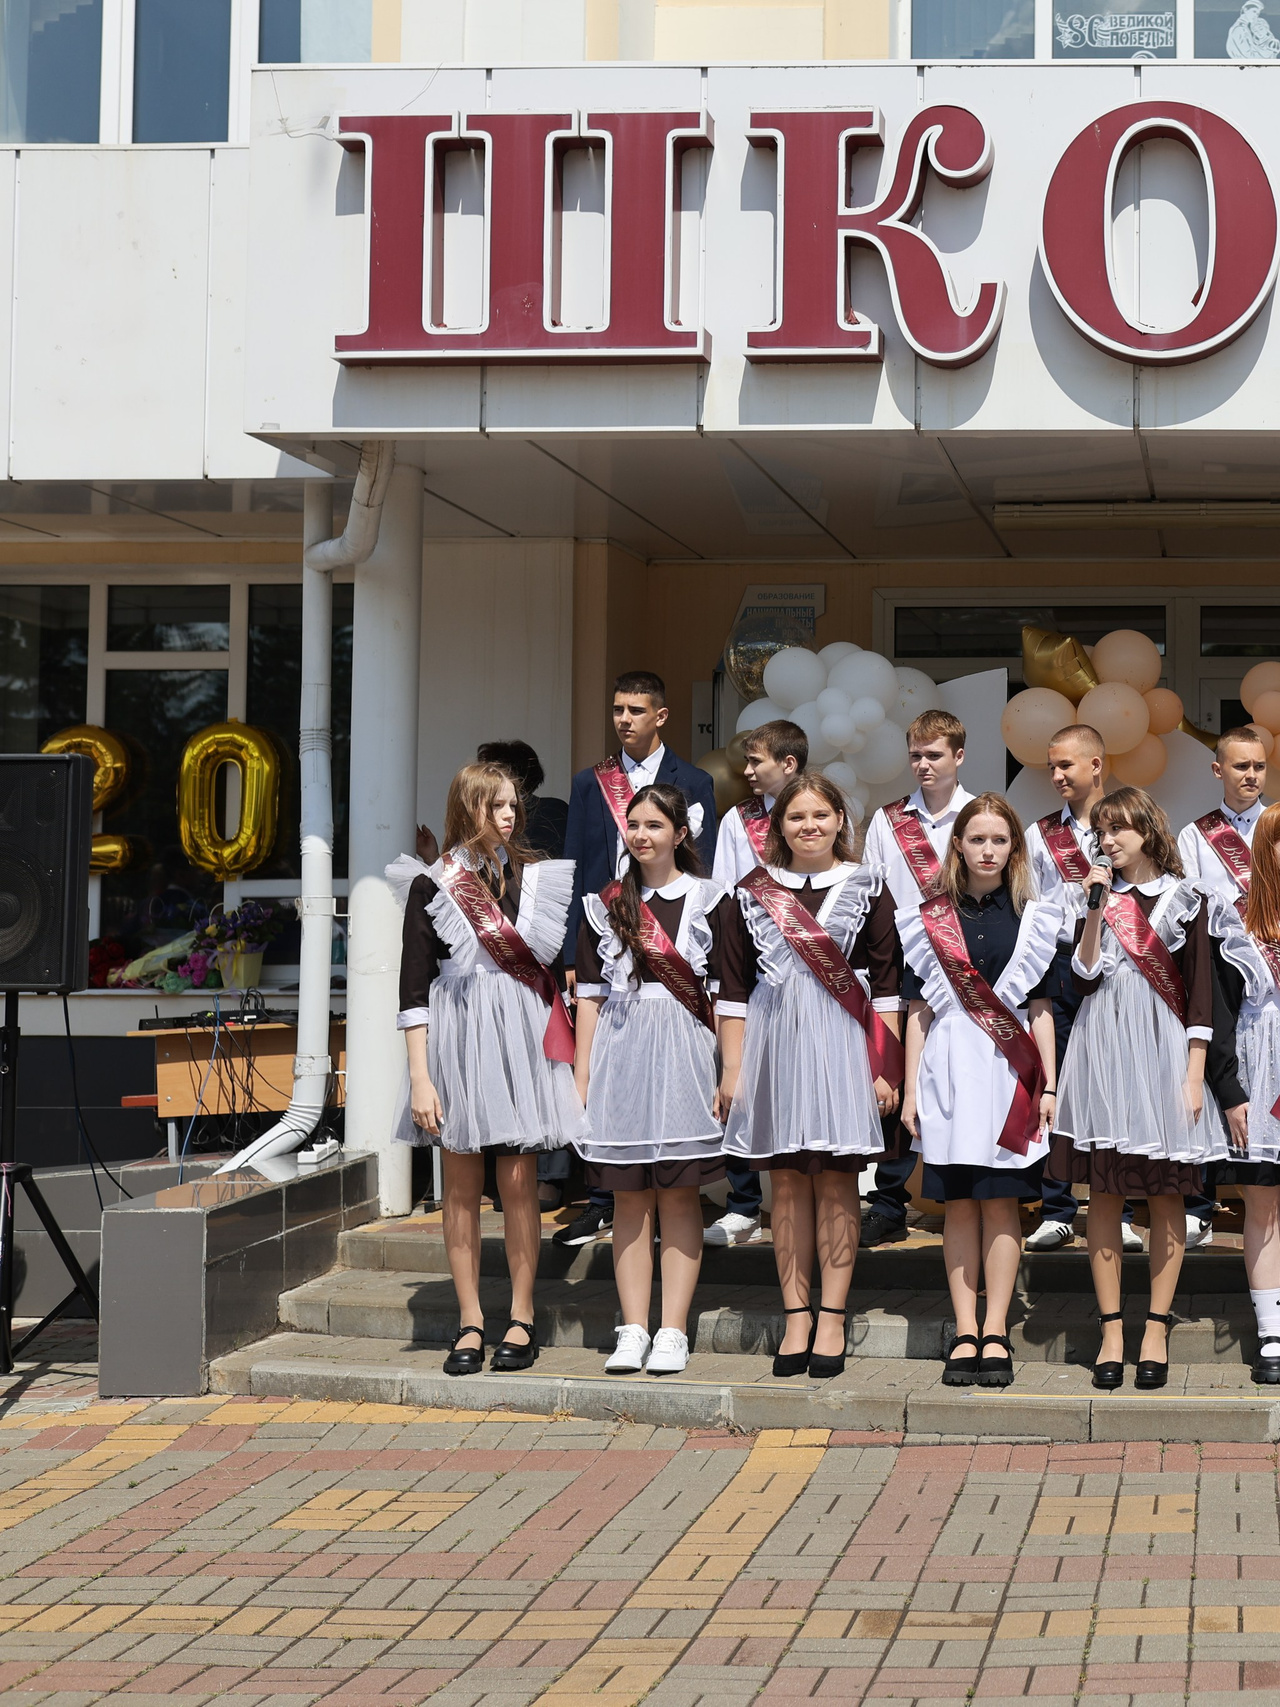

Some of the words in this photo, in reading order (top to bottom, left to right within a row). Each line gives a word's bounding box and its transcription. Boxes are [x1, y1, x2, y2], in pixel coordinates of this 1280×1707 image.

[1110, 12, 1174, 28] ВЕЛИКОЙ
[1110, 31, 1174, 49] ПОБЕДЫ!
[757, 592, 816, 601] ОБРАЗОВАНИЕ
[762, 888, 835, 970] Выпускница
[828, 966, 855, 994] 2025
[933, 922, 997, 1016] Выпускница
[985, 1015, 1021, 1041] 2025
